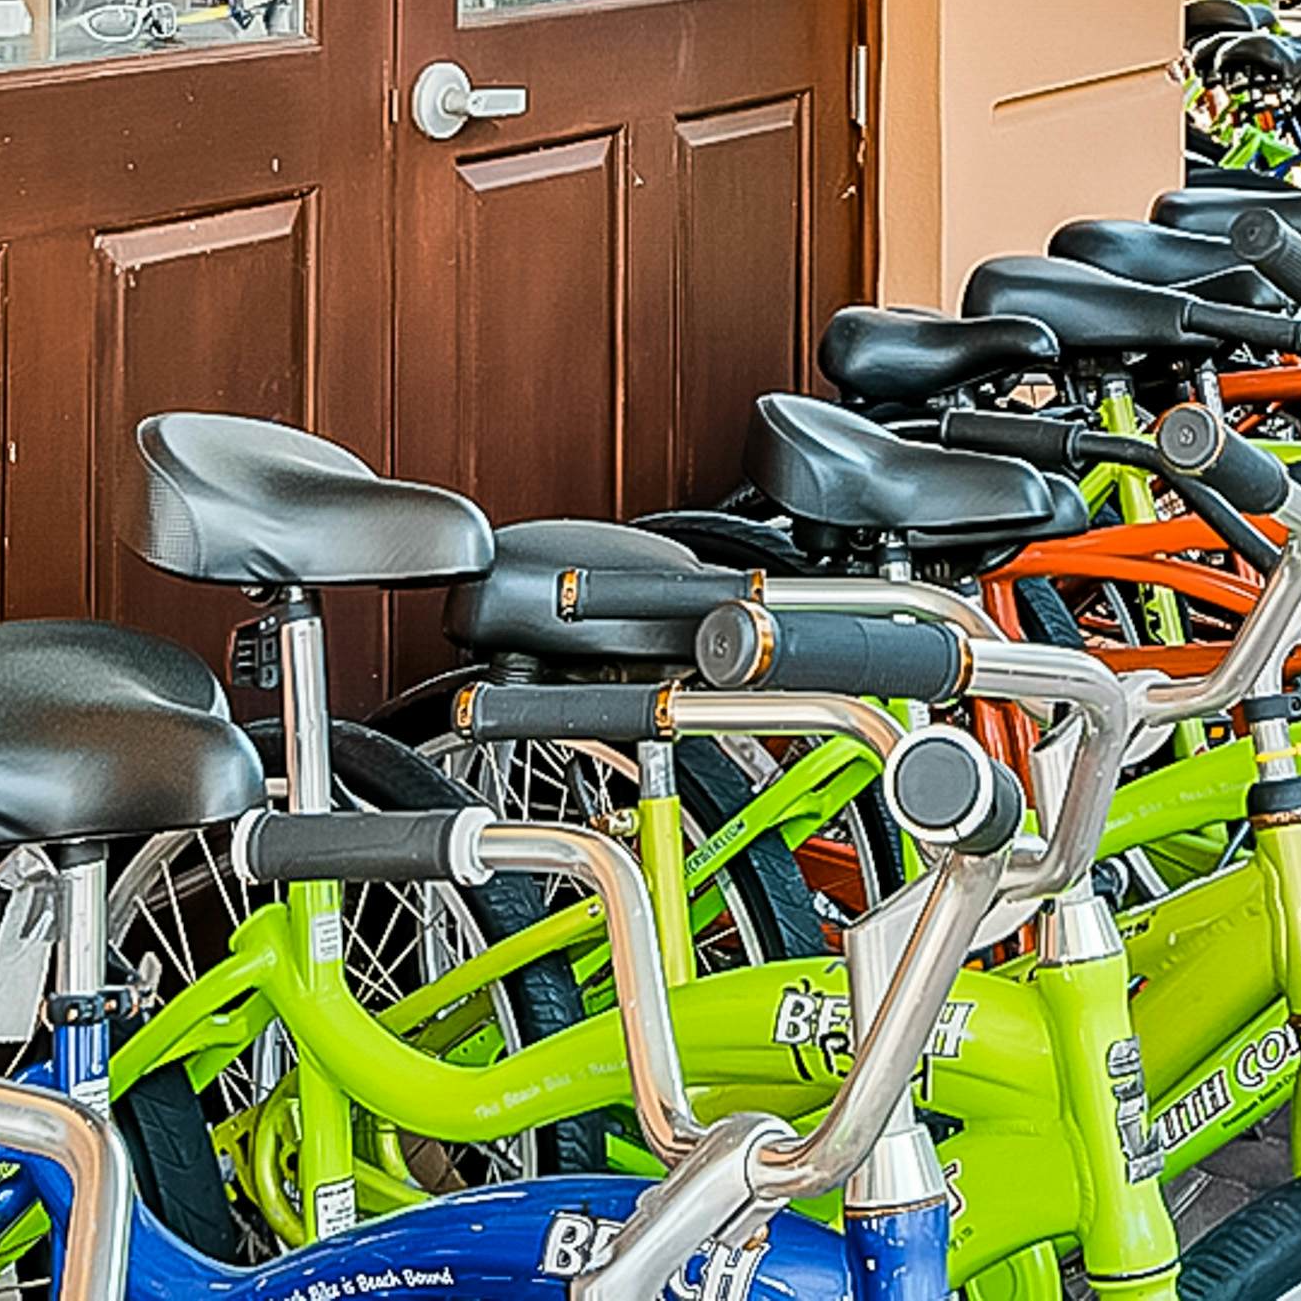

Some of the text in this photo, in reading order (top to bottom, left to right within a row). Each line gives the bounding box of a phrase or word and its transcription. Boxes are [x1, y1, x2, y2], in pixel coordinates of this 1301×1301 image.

[340, 1276, 356, 1295] is
[356, 1268, 403, 1292] Beach
[402, 1266, 455, 1288] Bound
